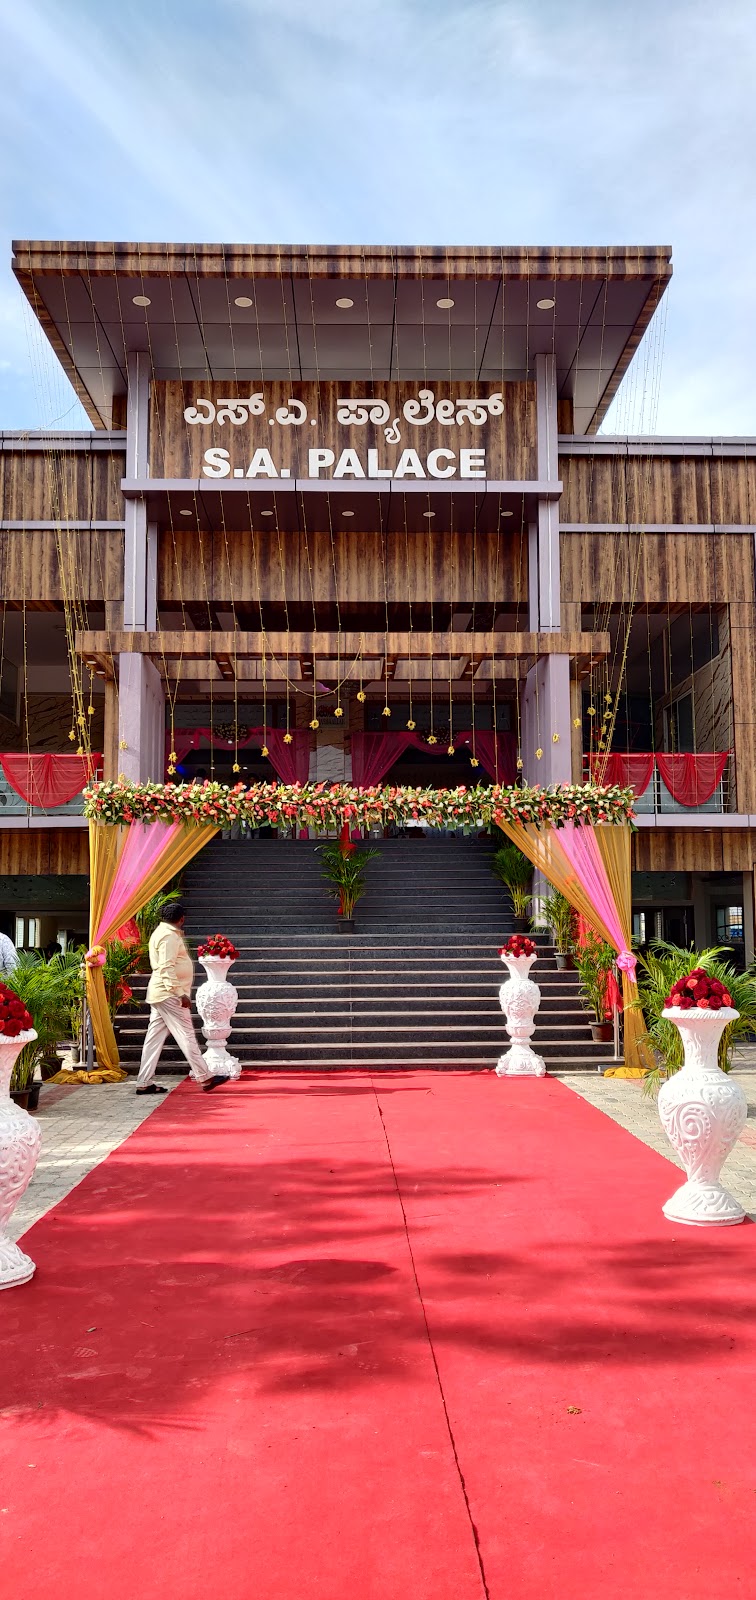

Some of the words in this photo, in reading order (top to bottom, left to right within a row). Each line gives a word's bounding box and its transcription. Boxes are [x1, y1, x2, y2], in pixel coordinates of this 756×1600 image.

[336, 389, 505, 445] ಪ್ಯಾಲೇಸ್
[202, 447, 291, 479] S.A.
[308, 447, 487, 479] PALACE
